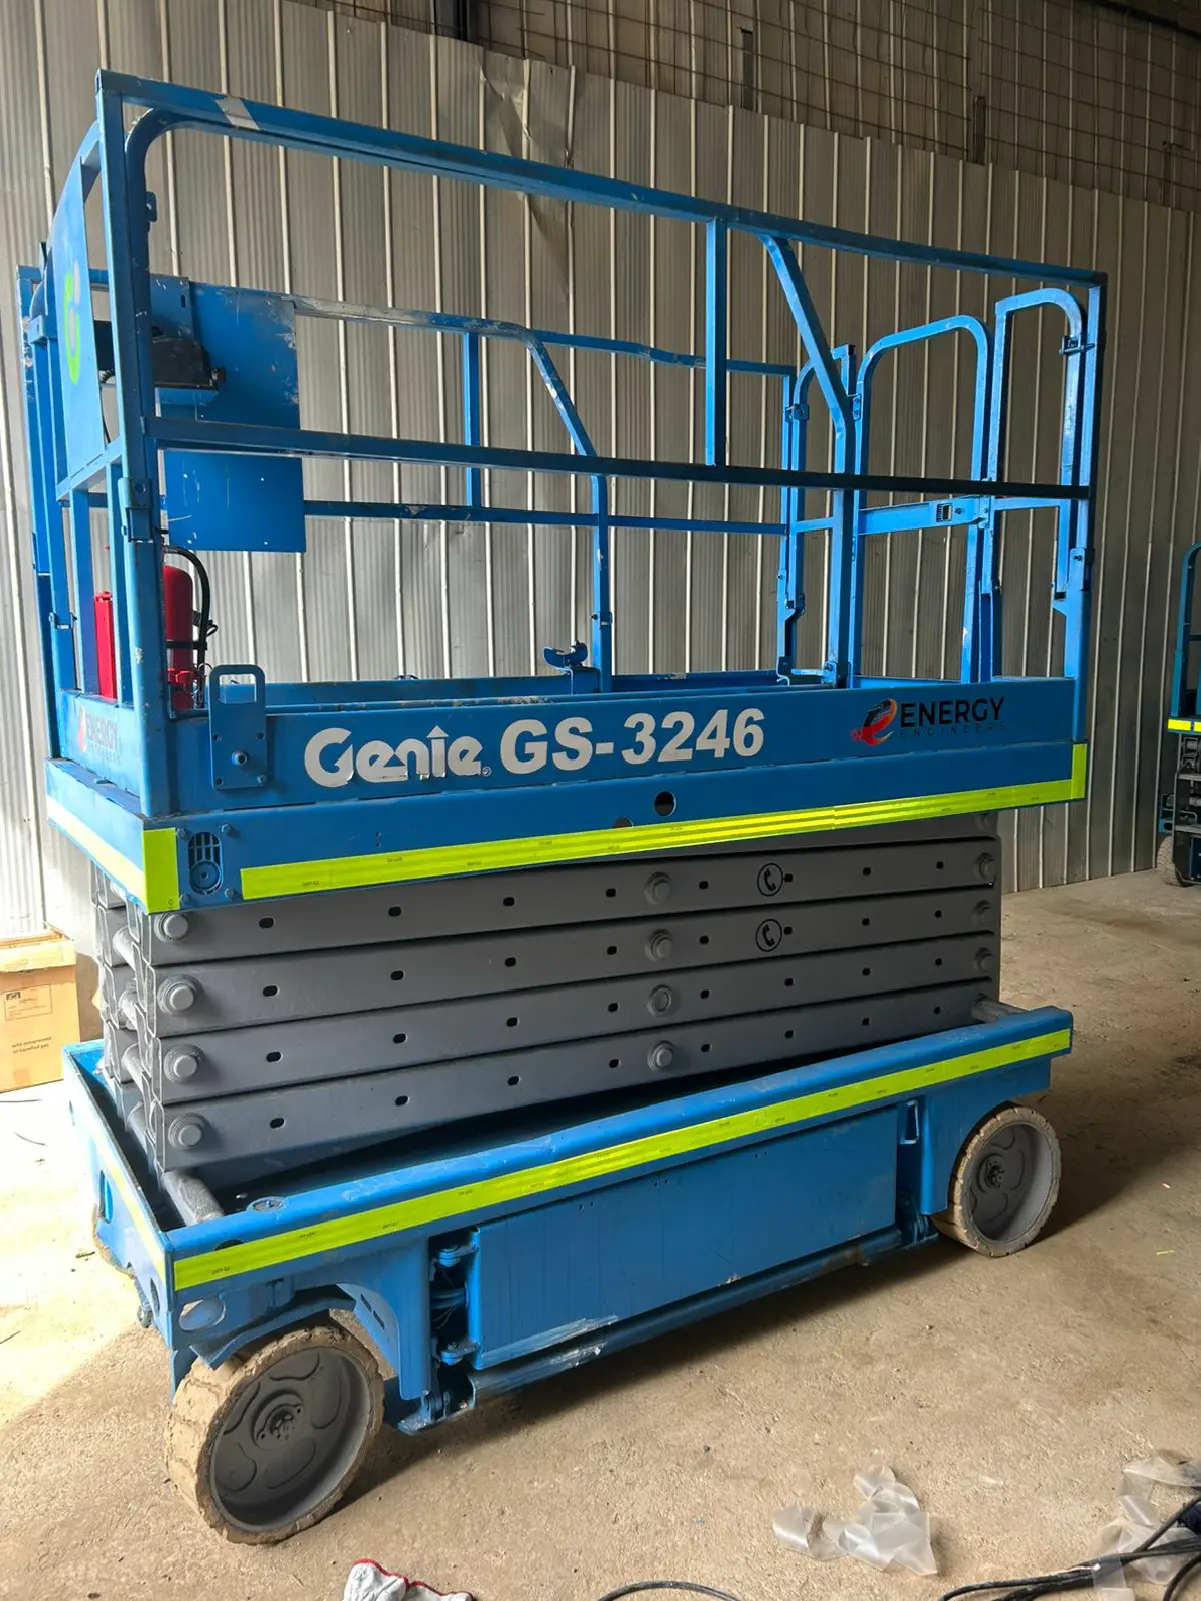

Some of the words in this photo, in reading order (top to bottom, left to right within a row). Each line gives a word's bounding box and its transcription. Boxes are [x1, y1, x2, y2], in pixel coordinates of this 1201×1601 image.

[900, 697, 1004, 728] ENERGY
[899, 721, 1005, 740] ENGINEERS
[304, 725, 483, 787] Genie
[500, 707, 764, 775] GS-3246
